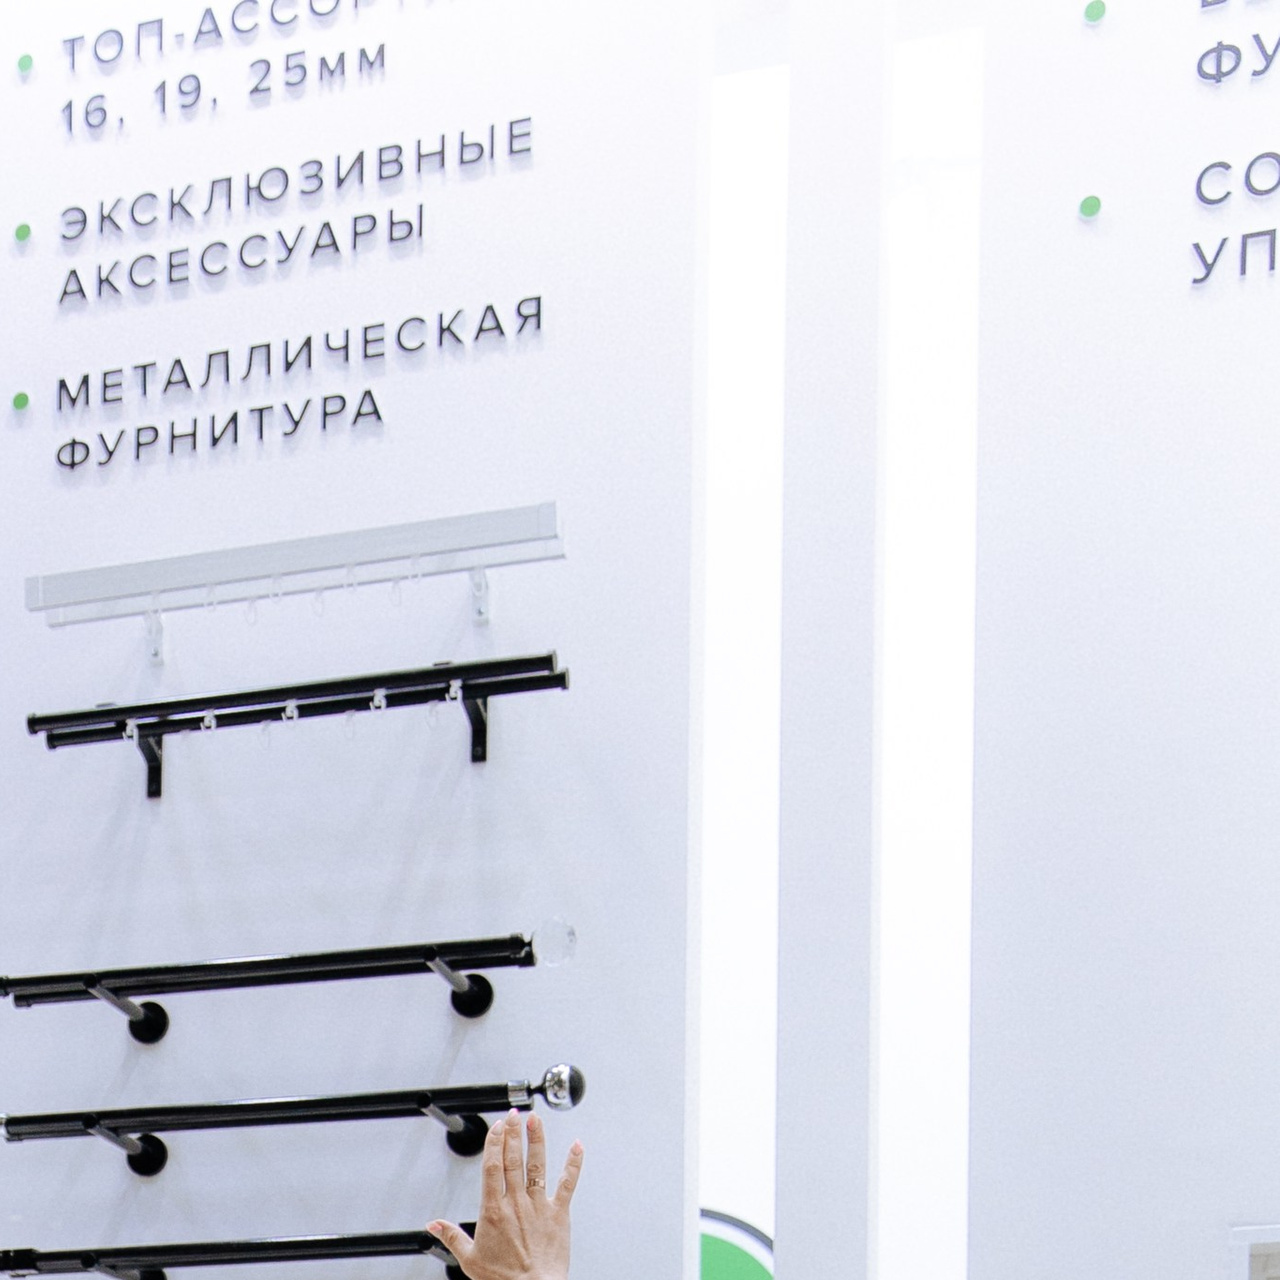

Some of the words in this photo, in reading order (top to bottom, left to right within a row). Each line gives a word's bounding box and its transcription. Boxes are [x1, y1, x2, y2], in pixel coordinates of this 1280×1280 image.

[61, 94, 125, 131] 16,
[154, 73, 218, 115] 19,
[249, 43, 387, 96] 25мм
[60, 117, 534, 242] ЭКСКЛЮЗИВНЫЕ
[58, 204, 426, 305] АКСЕССУАРЫ
[1192, 229, 1277, 285] УП
[58, 296, 545, 412] МЕТАЛЛИЧЕСКАЯ
[56, 390, 384, 471] ФУРНИТУРА
